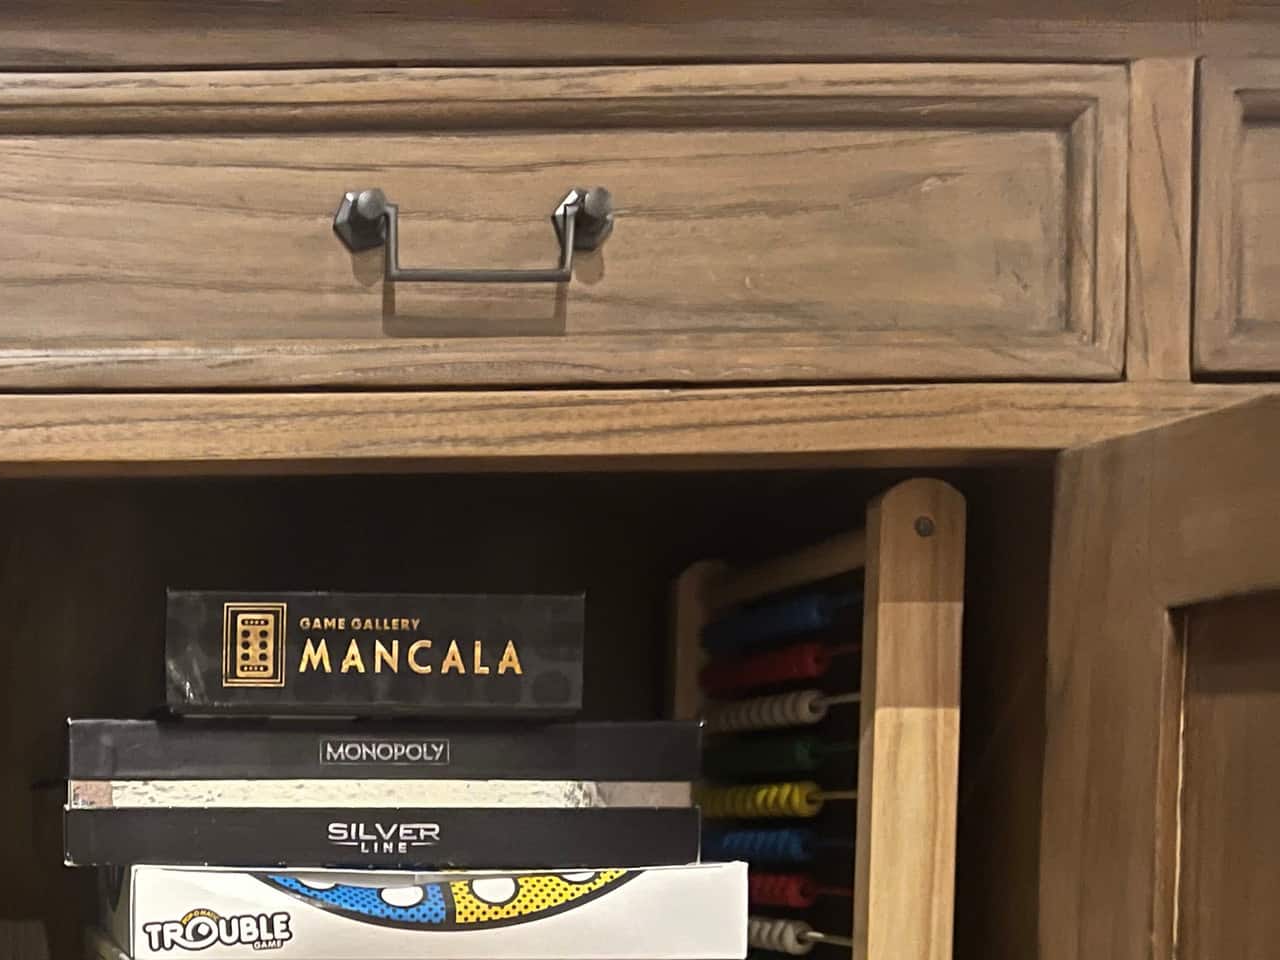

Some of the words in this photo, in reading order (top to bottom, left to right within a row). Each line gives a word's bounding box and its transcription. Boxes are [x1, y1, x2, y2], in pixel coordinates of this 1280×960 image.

[299, 618, 347, 631] GAME
[351, 618, 421, 631] GALLERY
[298, 638, 525, 676] MANCALA
[325, 741, 445, 762] MONOPOLY
[327, 822, 441, 843] SILVER
[360, 842, 408, 854] LINE
[143, 912, 293, 951] TROUBLE
[254, 941, 283, 949] GAME
